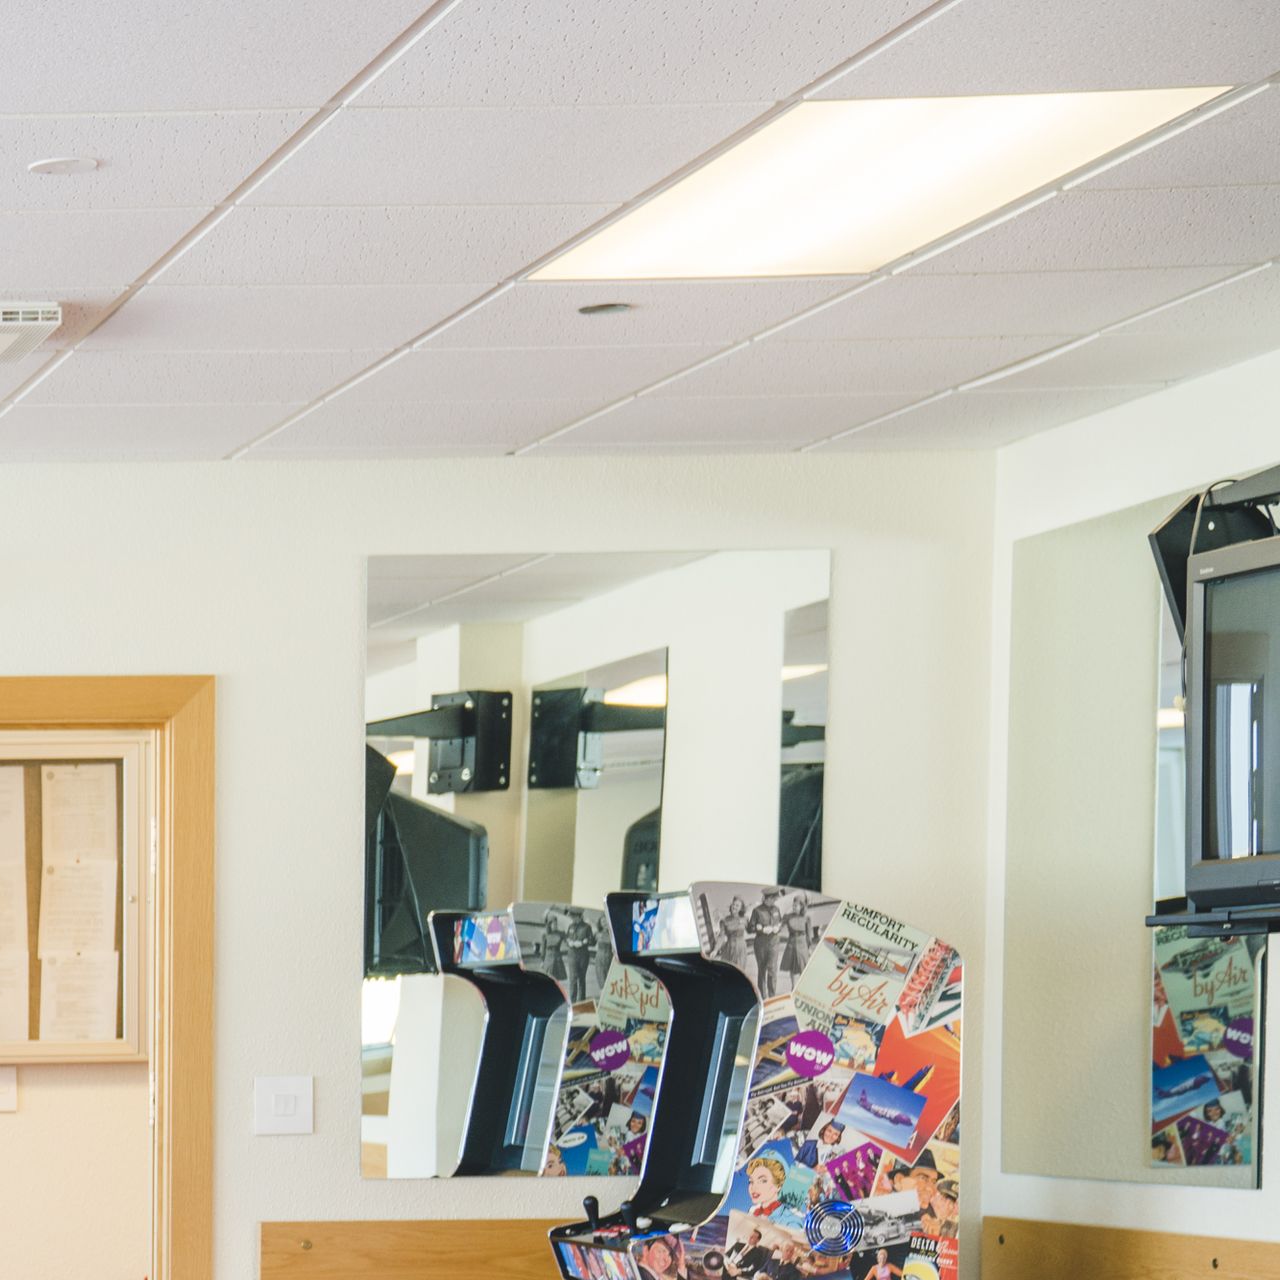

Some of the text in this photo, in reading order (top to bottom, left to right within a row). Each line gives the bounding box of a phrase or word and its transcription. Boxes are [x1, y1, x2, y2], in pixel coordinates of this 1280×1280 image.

[827, 962, 888, 1015] by Air
[911, 1237, 935, 1251] DELTA
